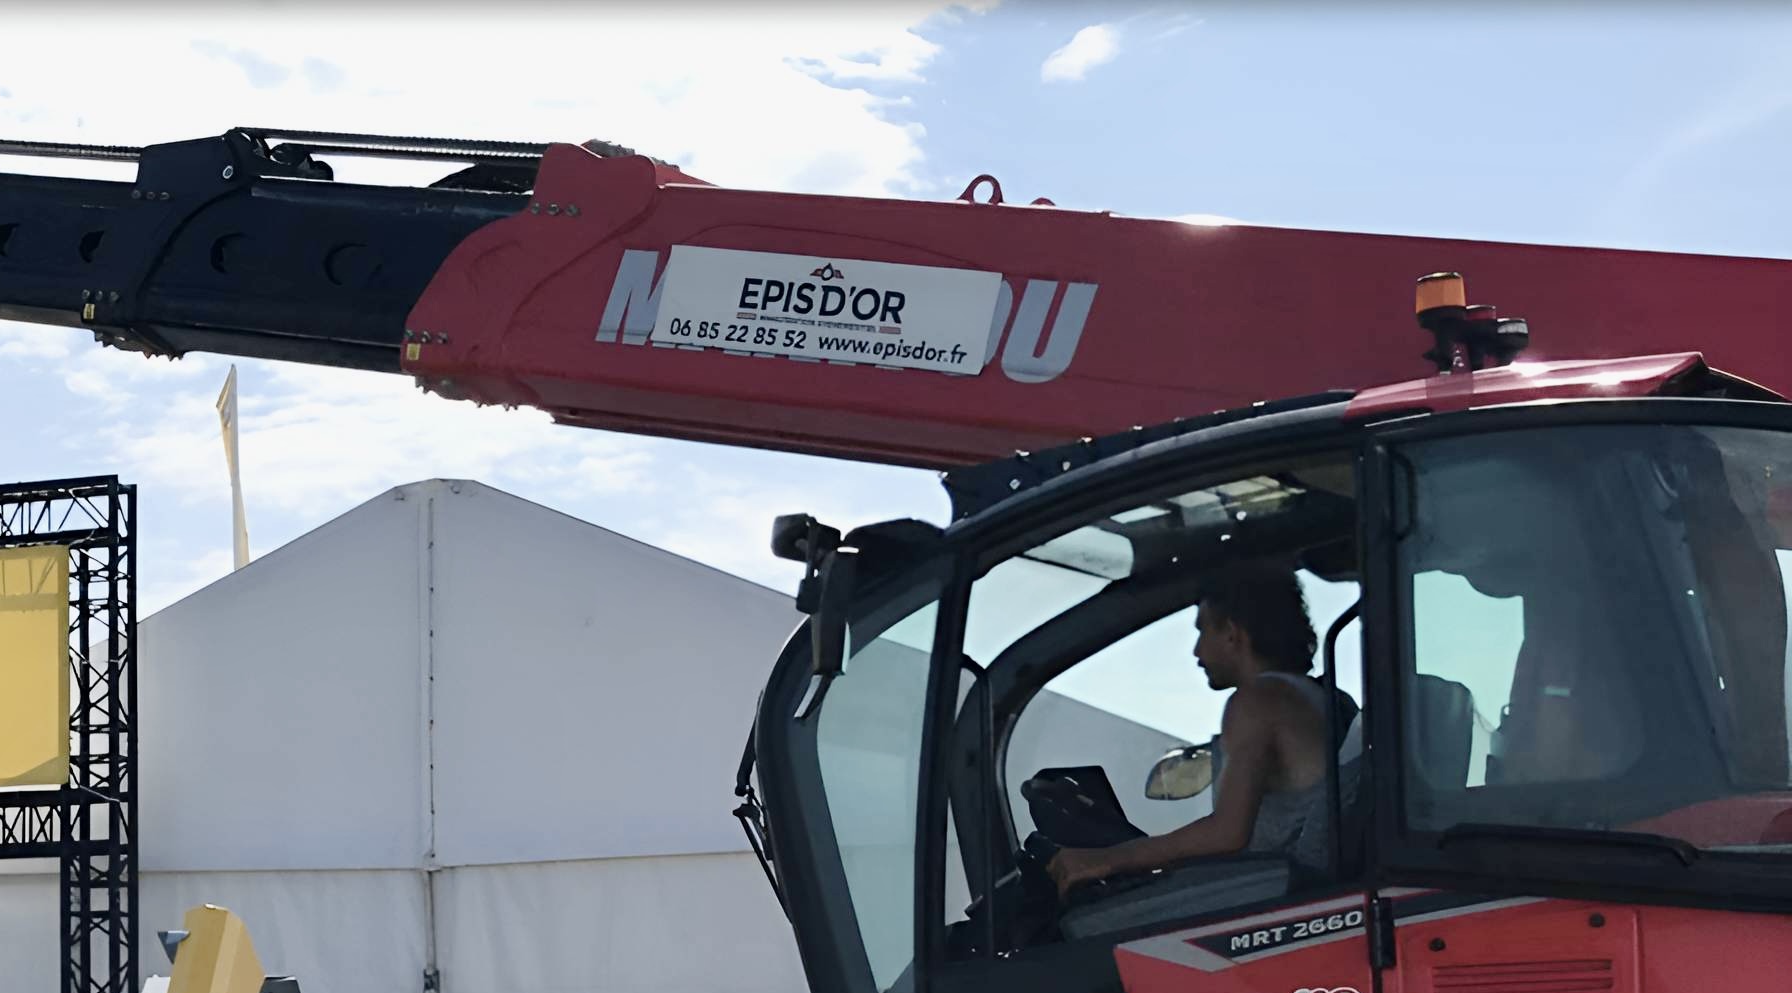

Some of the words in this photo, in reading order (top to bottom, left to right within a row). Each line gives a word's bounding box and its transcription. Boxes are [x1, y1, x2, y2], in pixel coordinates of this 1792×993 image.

[670, 317, 692, 337] 06
[697, 321, 721, 340] 85
[725, 324, 749, 343] 22
[753, 327, 778, 346] 85
[782, 330, 807, 349] 52
[818, 336, 967, 365] www.episdor.fr
[1231, 926, 1288, 950] MRT
[1293, 911, 1363, 938] 2660
